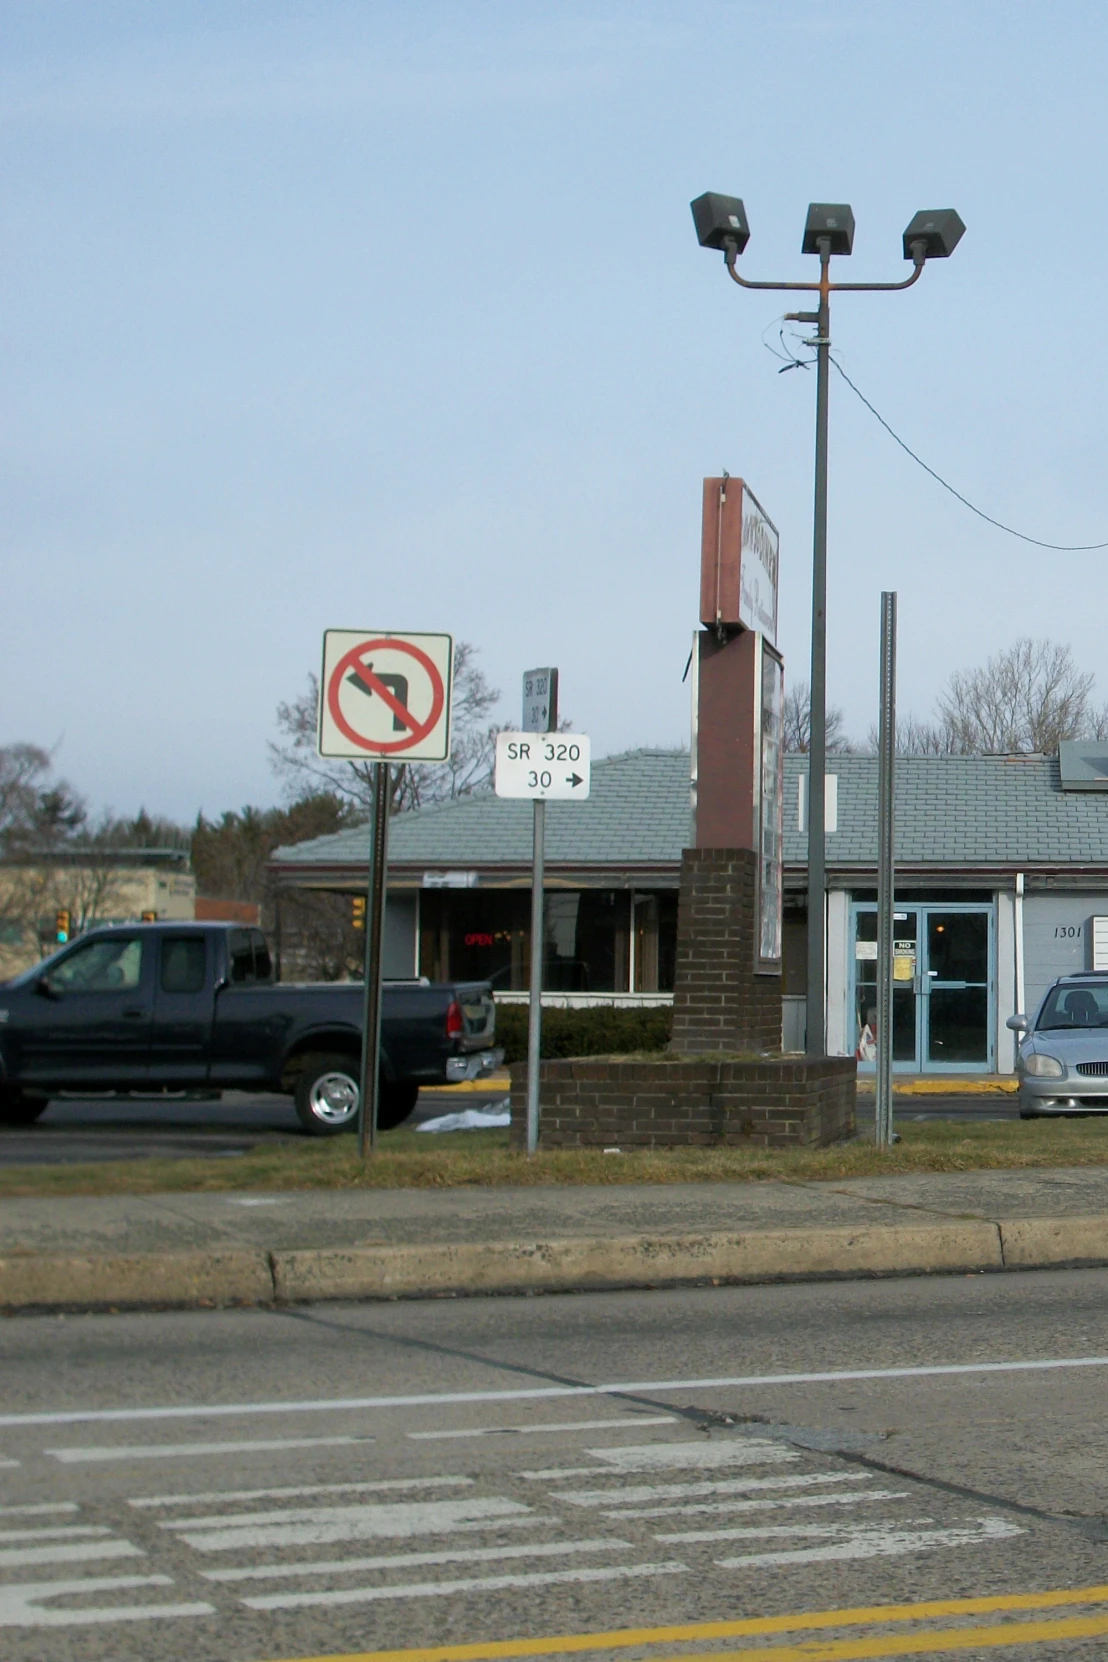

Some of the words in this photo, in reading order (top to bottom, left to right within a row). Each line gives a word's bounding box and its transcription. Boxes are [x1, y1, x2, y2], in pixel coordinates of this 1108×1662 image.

[507, 743, 530, 760] SR
[544, 743, 580, 761] 320
[527, 770, 552, 788] 30
[464, 933, 492, 946] OPEN
[1054, 926, 1082, 938] 1301
